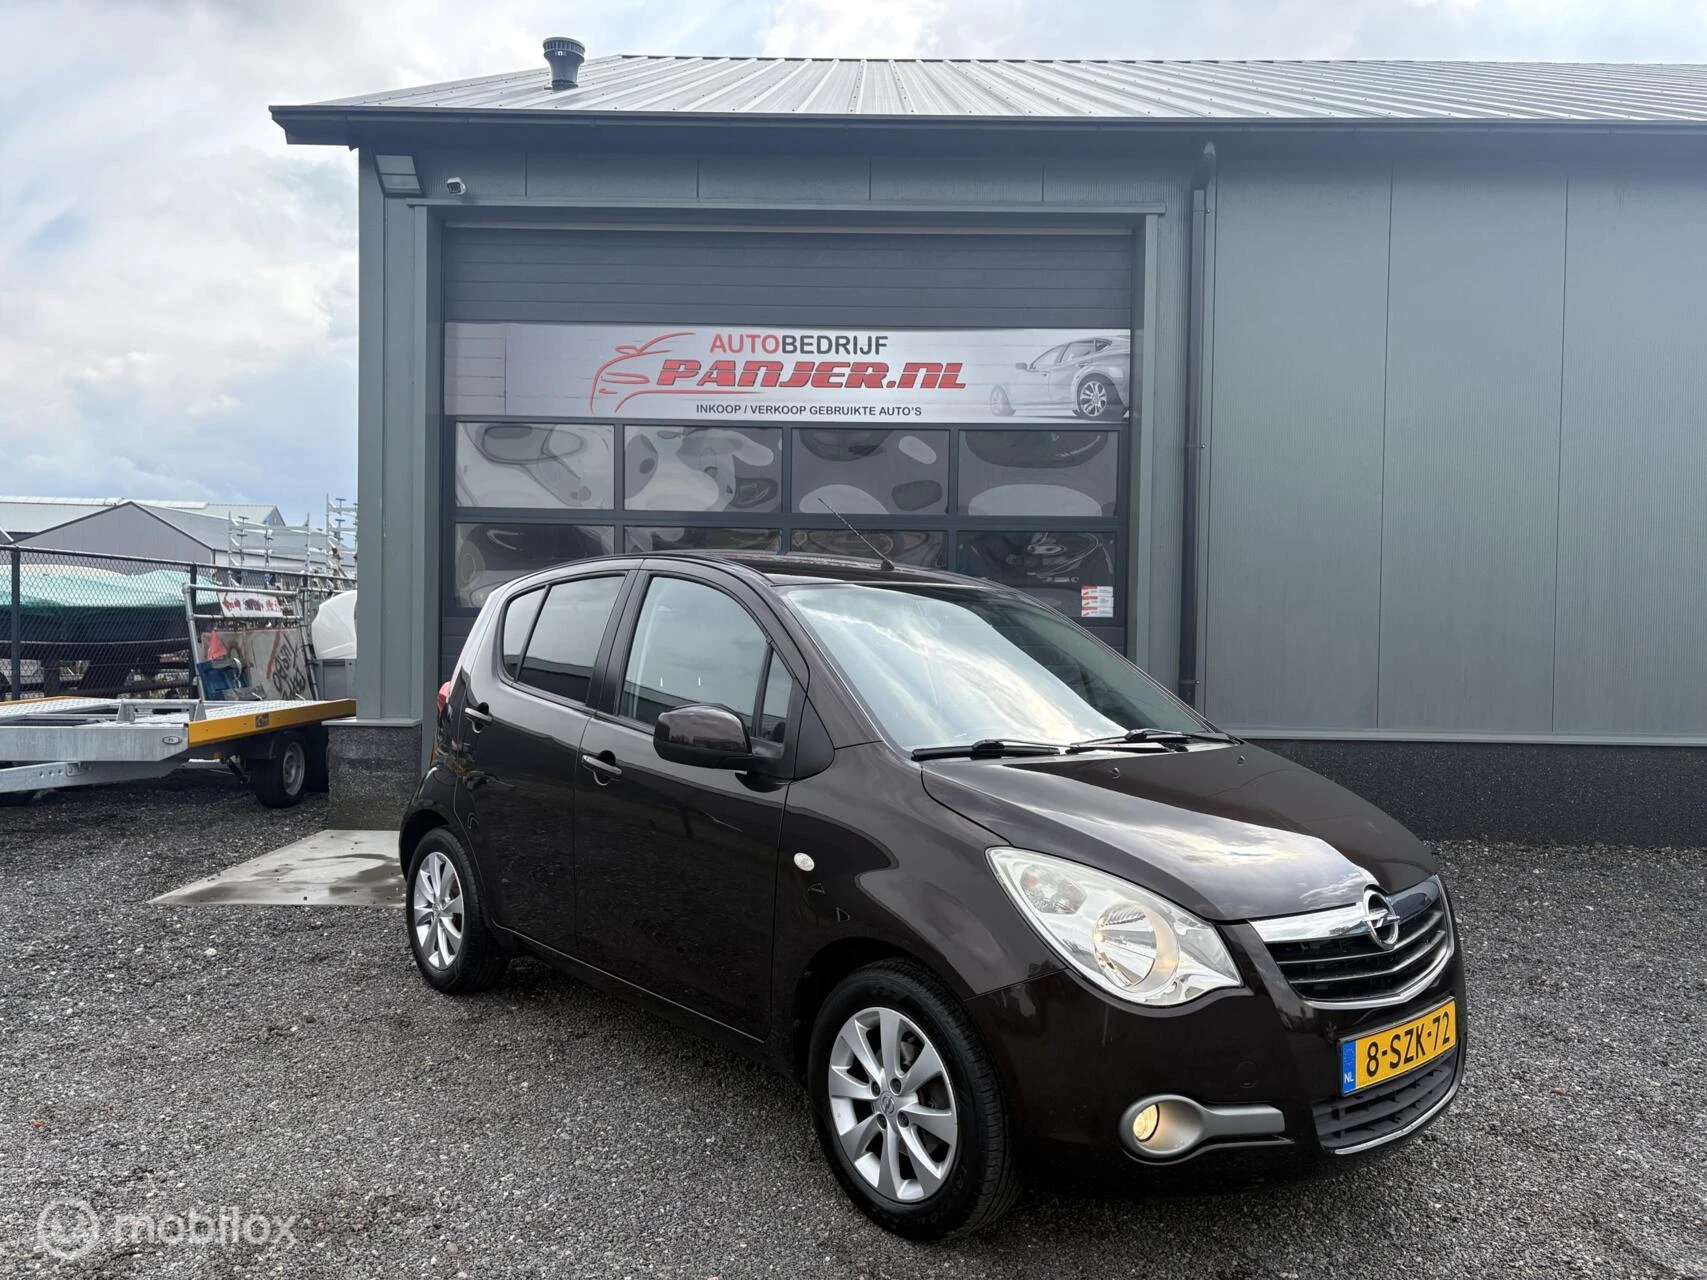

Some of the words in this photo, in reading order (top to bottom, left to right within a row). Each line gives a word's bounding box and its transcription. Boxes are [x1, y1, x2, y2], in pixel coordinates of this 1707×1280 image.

[710, 334, 888, 354] AUTOBEDRIJF
[696, 404, 742, 415] INKOOP
[750, 404, 807, 416] VERKOOP
[809, 405, 876, 417] GEBRUIKTE
[879, 406, 922, 416] AUTO'S
[1366, 1011, 1450, 1077] 8-SZK-72
[1344, 1072, 1354, 1084] NL
